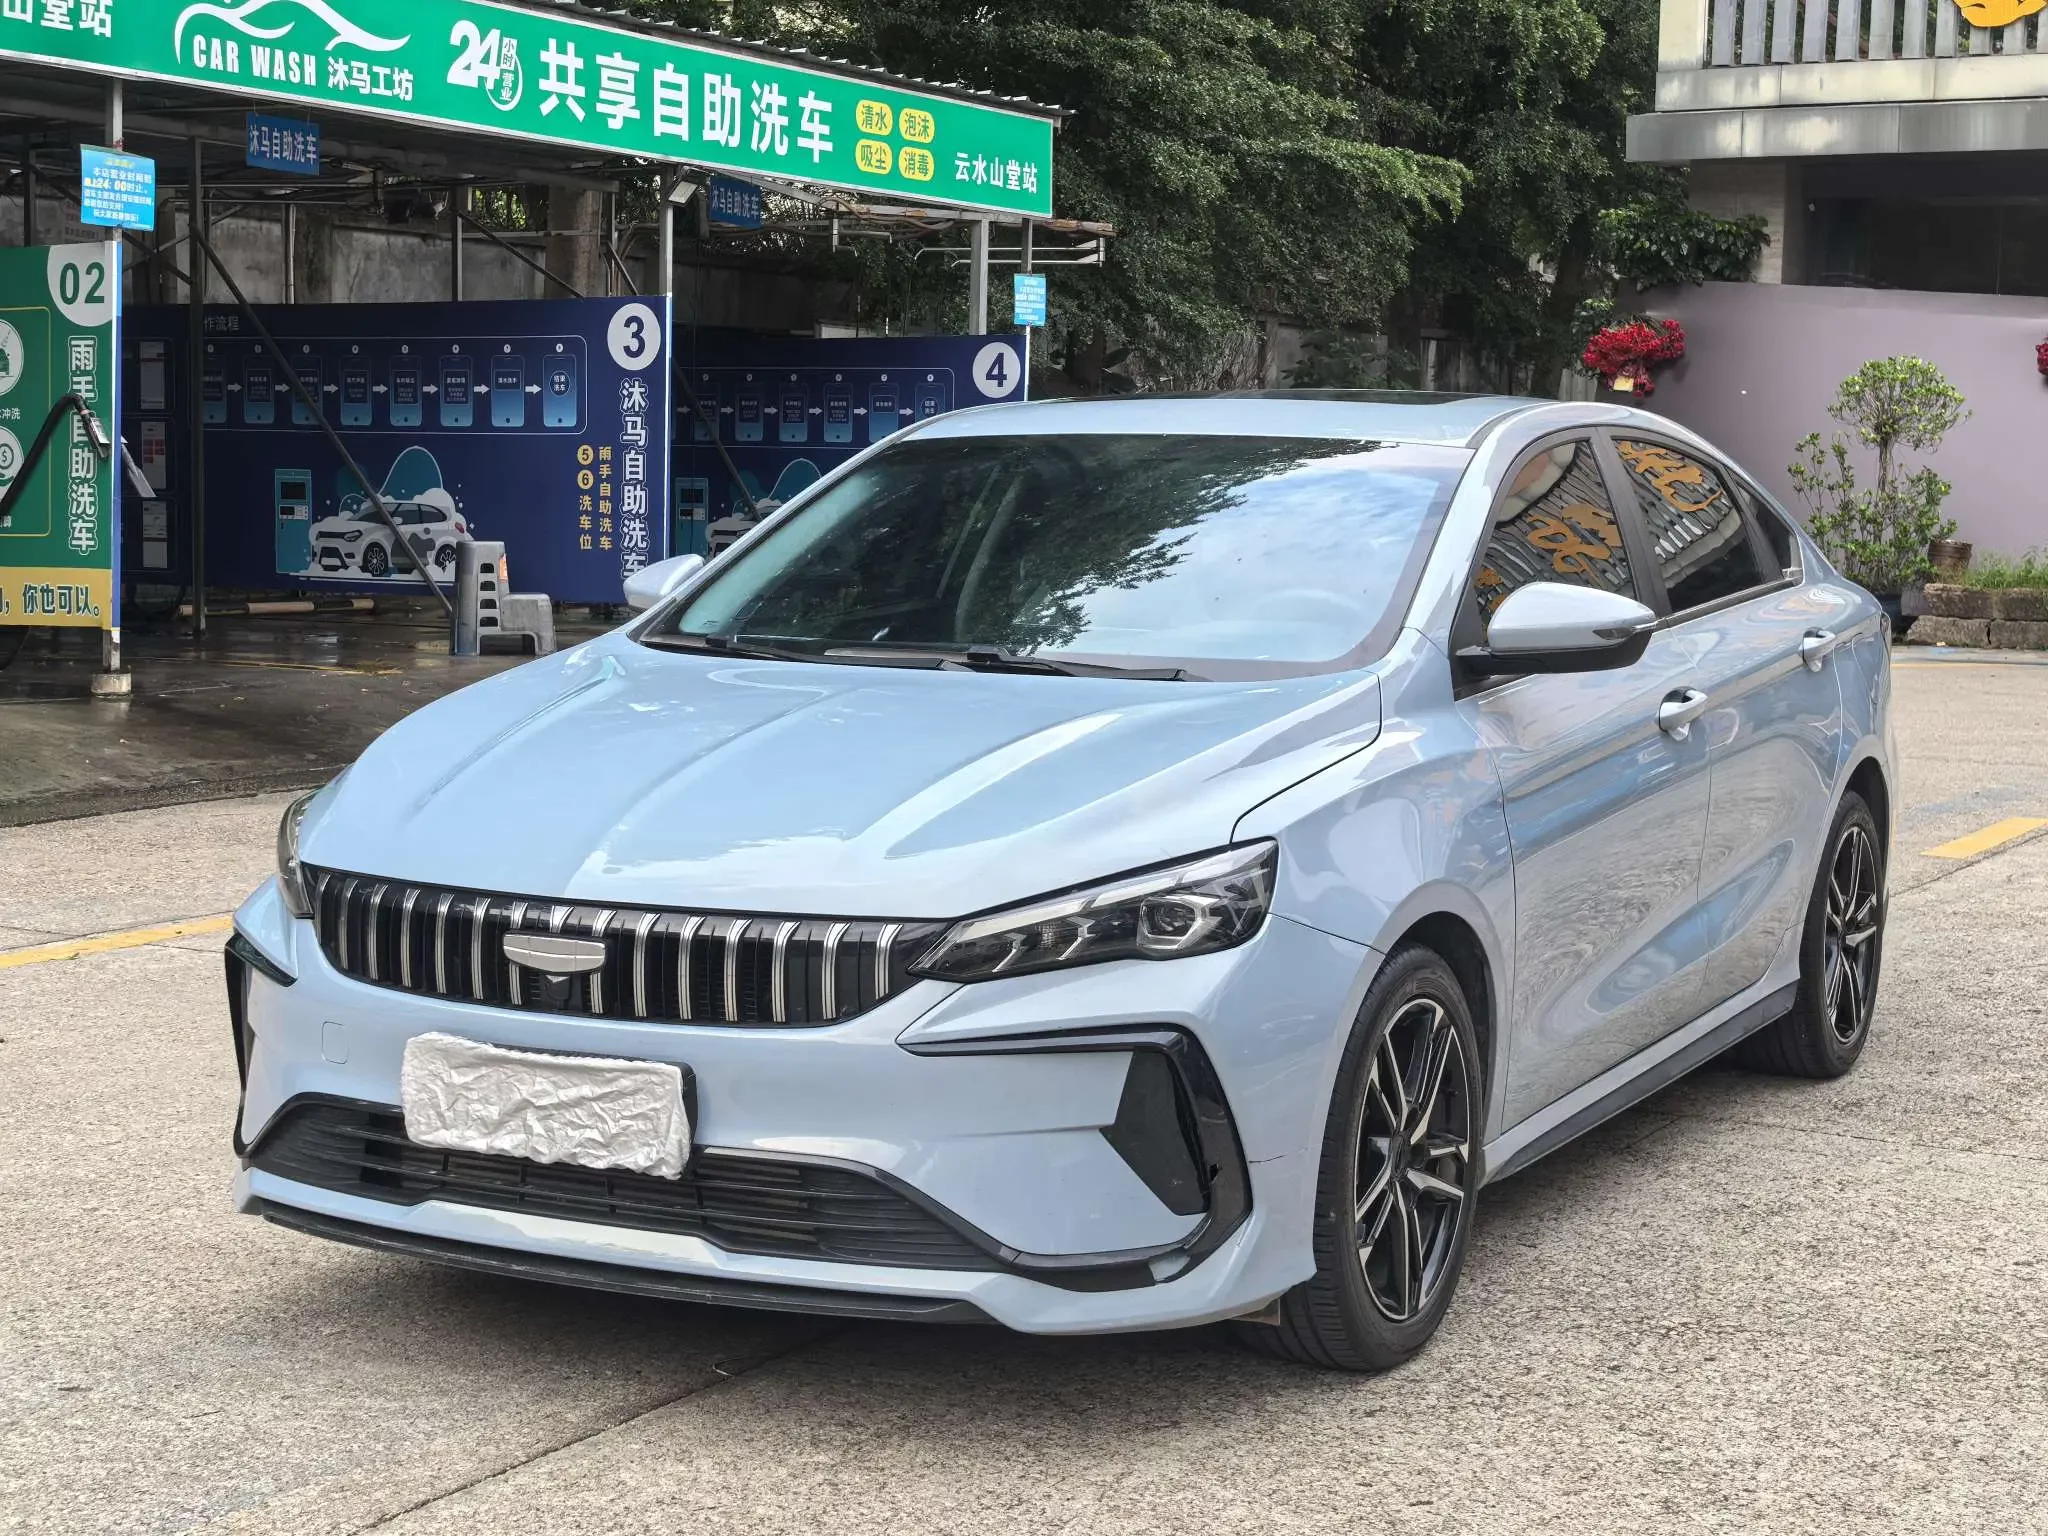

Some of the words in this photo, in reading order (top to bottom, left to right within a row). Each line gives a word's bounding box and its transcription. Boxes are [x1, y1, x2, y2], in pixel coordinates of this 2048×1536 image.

[193, 34, 240, 74] CAR
[250, 44, 317, 87] WASH
[447, 19, 501, 89] 24
[327, 55, 414, 102] 沐马工坊
[538, 38, 834, 164] 共享自助洗车
[861, 103, 888, 131] 清水
[249, 123, 317, 166] 沐马自助洗车
[903, 111, 931, 140] 泡沫
[860, 143, 888, 172] 吸尘
[903, 151, 930, 178] 消毒
[954, 151, 1038, 195] 云水山堂站
[59, 262, 105, 305] 02
[623, 315, 646, 359] 3
[985, 352, 1008, 388] 4
[0, 407, 21, 420] 冲洗
[598, 446, 613, 551] 雨手自助洗车
[621, 379, 648, 578] 沐马自助洗车
